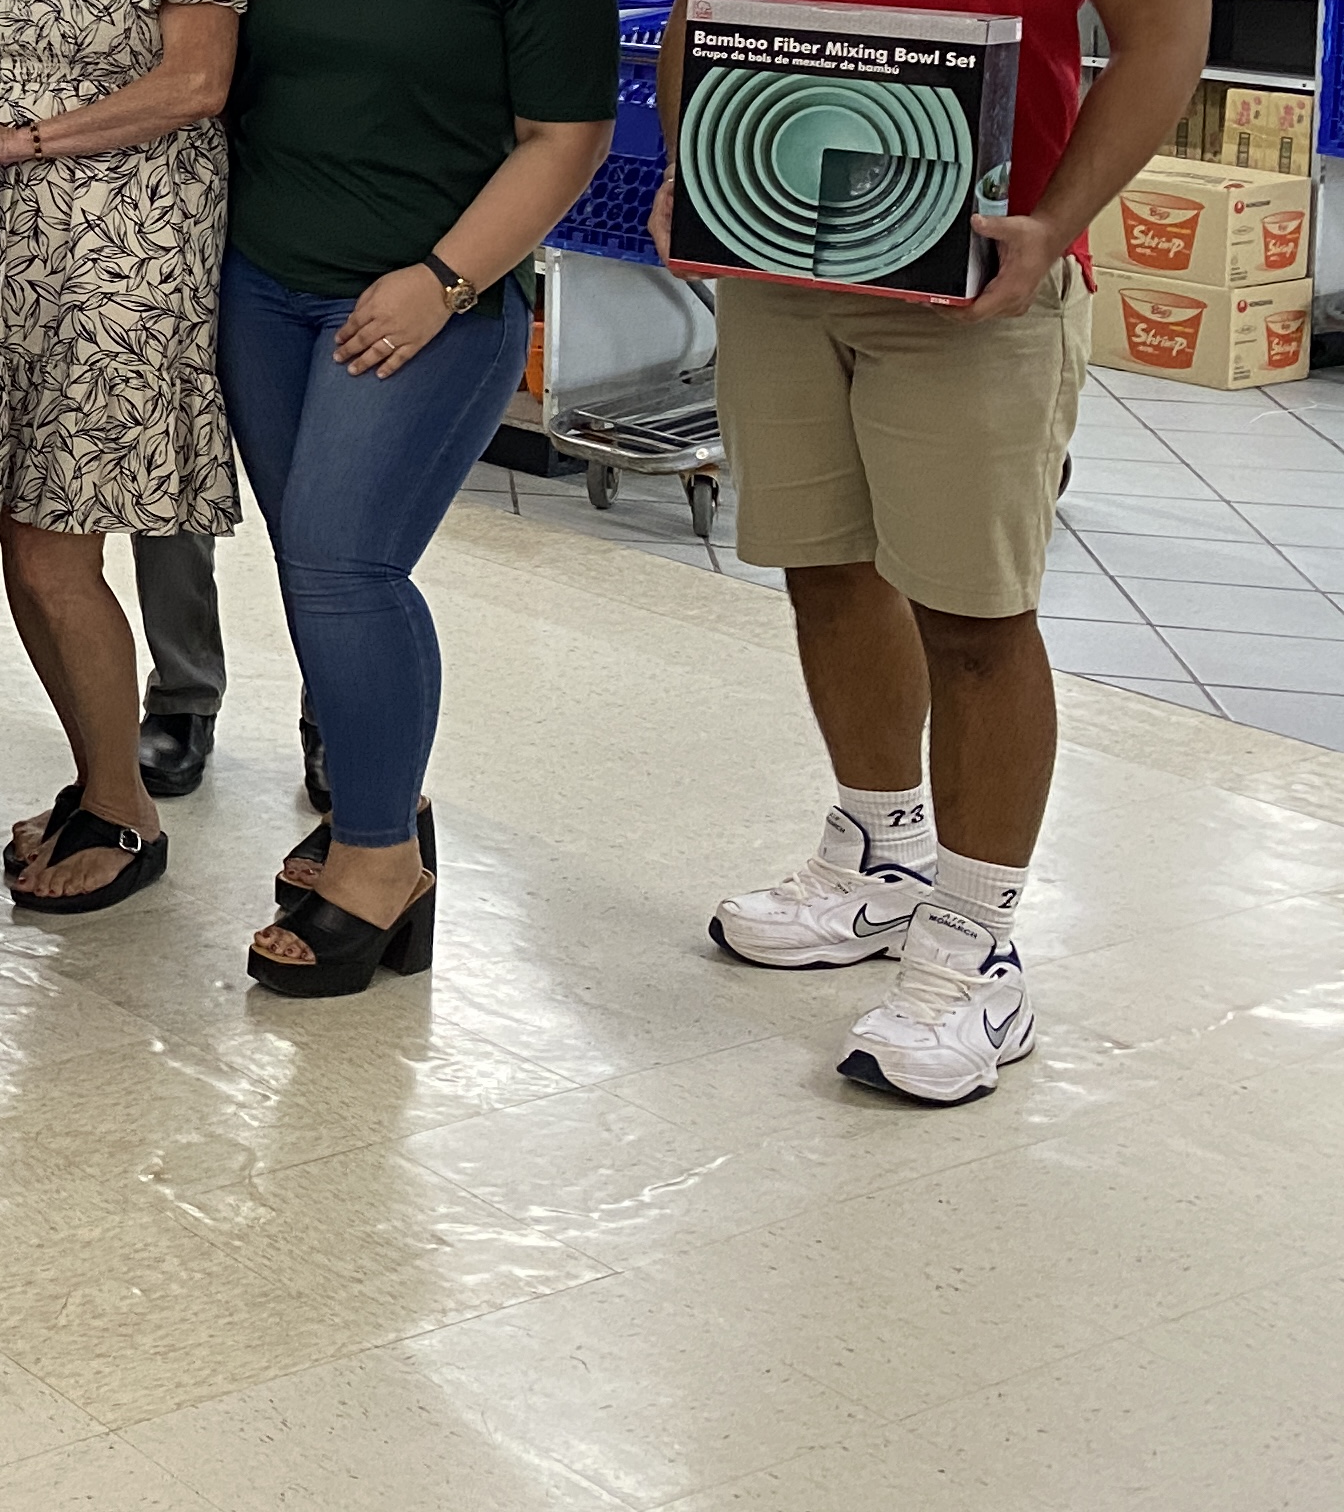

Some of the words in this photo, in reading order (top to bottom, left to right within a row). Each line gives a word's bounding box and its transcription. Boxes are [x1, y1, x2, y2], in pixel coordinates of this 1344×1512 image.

[692, 48, 728, 61] Grupo
[731, 50, 745, 61] de
[748, 52, 772, 63] bols
[774, 55, 789, 65] de
[840, 60, 855, 71] de
[858, 61, 900, 74] bambú
[694, 30, 768, 50] Bamboo
[774, 37, 821, 54] Fiber
[825, 41, 888, 63] Mixing
[894, 48, 940, 65] Bowl
[945, 52, 976, 68] Set
[1131, 225, 1184, 259] Shrimp
[1132, 322, 1187, 361] Shrimp
[928, 914, 978, 939] MONARCH
[942, 914, 966, 925] AIR
